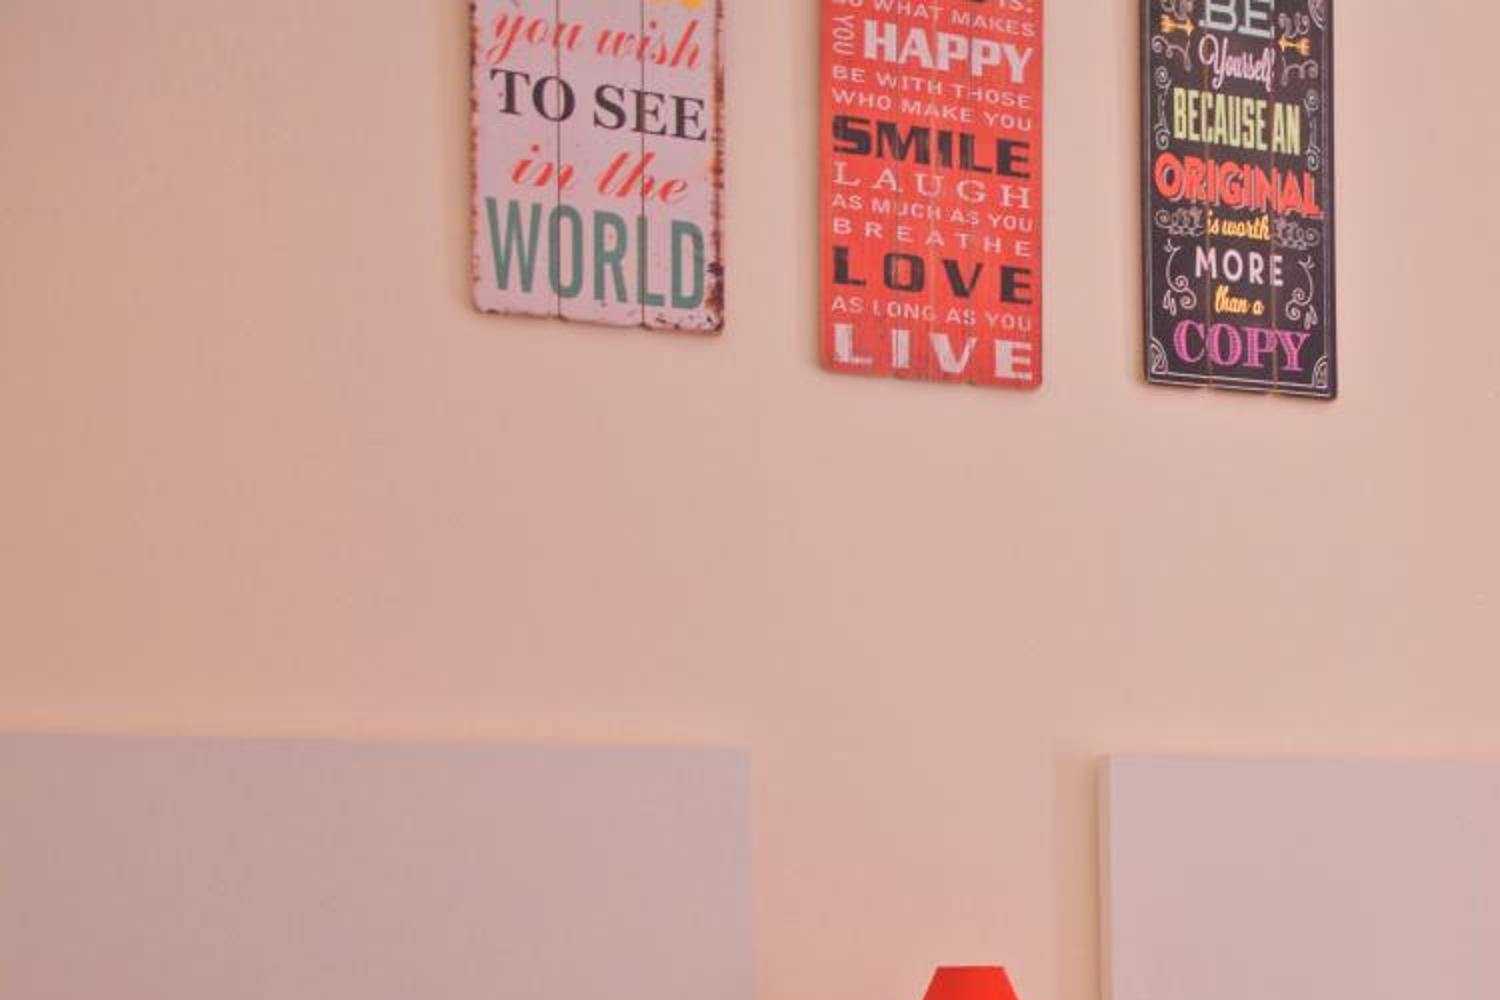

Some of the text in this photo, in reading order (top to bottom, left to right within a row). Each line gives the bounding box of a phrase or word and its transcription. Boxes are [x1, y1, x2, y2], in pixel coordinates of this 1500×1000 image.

[485, 12, 700, 69] you wish
[832, 15, 855, 55] YOU
[874, 0, 944, 20] WHAT
[951, 10, 1035, 37] MAKES
[1198, 0, 1275, 39] BE
[864, 19, 1033, 84] HAPPY
[490, 68, 707, 141] TO SEE
[832, 65, 1032, 110] BE WITH THOSE
[832, 88, 1031, 132] WHO MAKE YOU
[1173, 87, 1300, 156] BECAUSE AN
[832, 115, 1031, 179] SMILE
[511, 144, 688, 202] in the
[833, 161, 1031, 208] LAUGH
[1154, 152, 1325, 219] ORIGINAL
[832, 194, 1033, 233] AS MUCH AS YOU
[1207, 210, 1271, 241] is worth
[485, 196, 706, 309] WORLD
[832, 218, 1032, 257] BREATHE
[832, 245, 1032, 304] LOVE
[1195, 246, 1284, 286] MORE
[832, 296, 1032, 332] AS LONG AS YOU
[1215, 285, 1265, 315] than a
[833, 323, 1033, 381] LIVE
[1173, 320, 1310, 372] COPY
